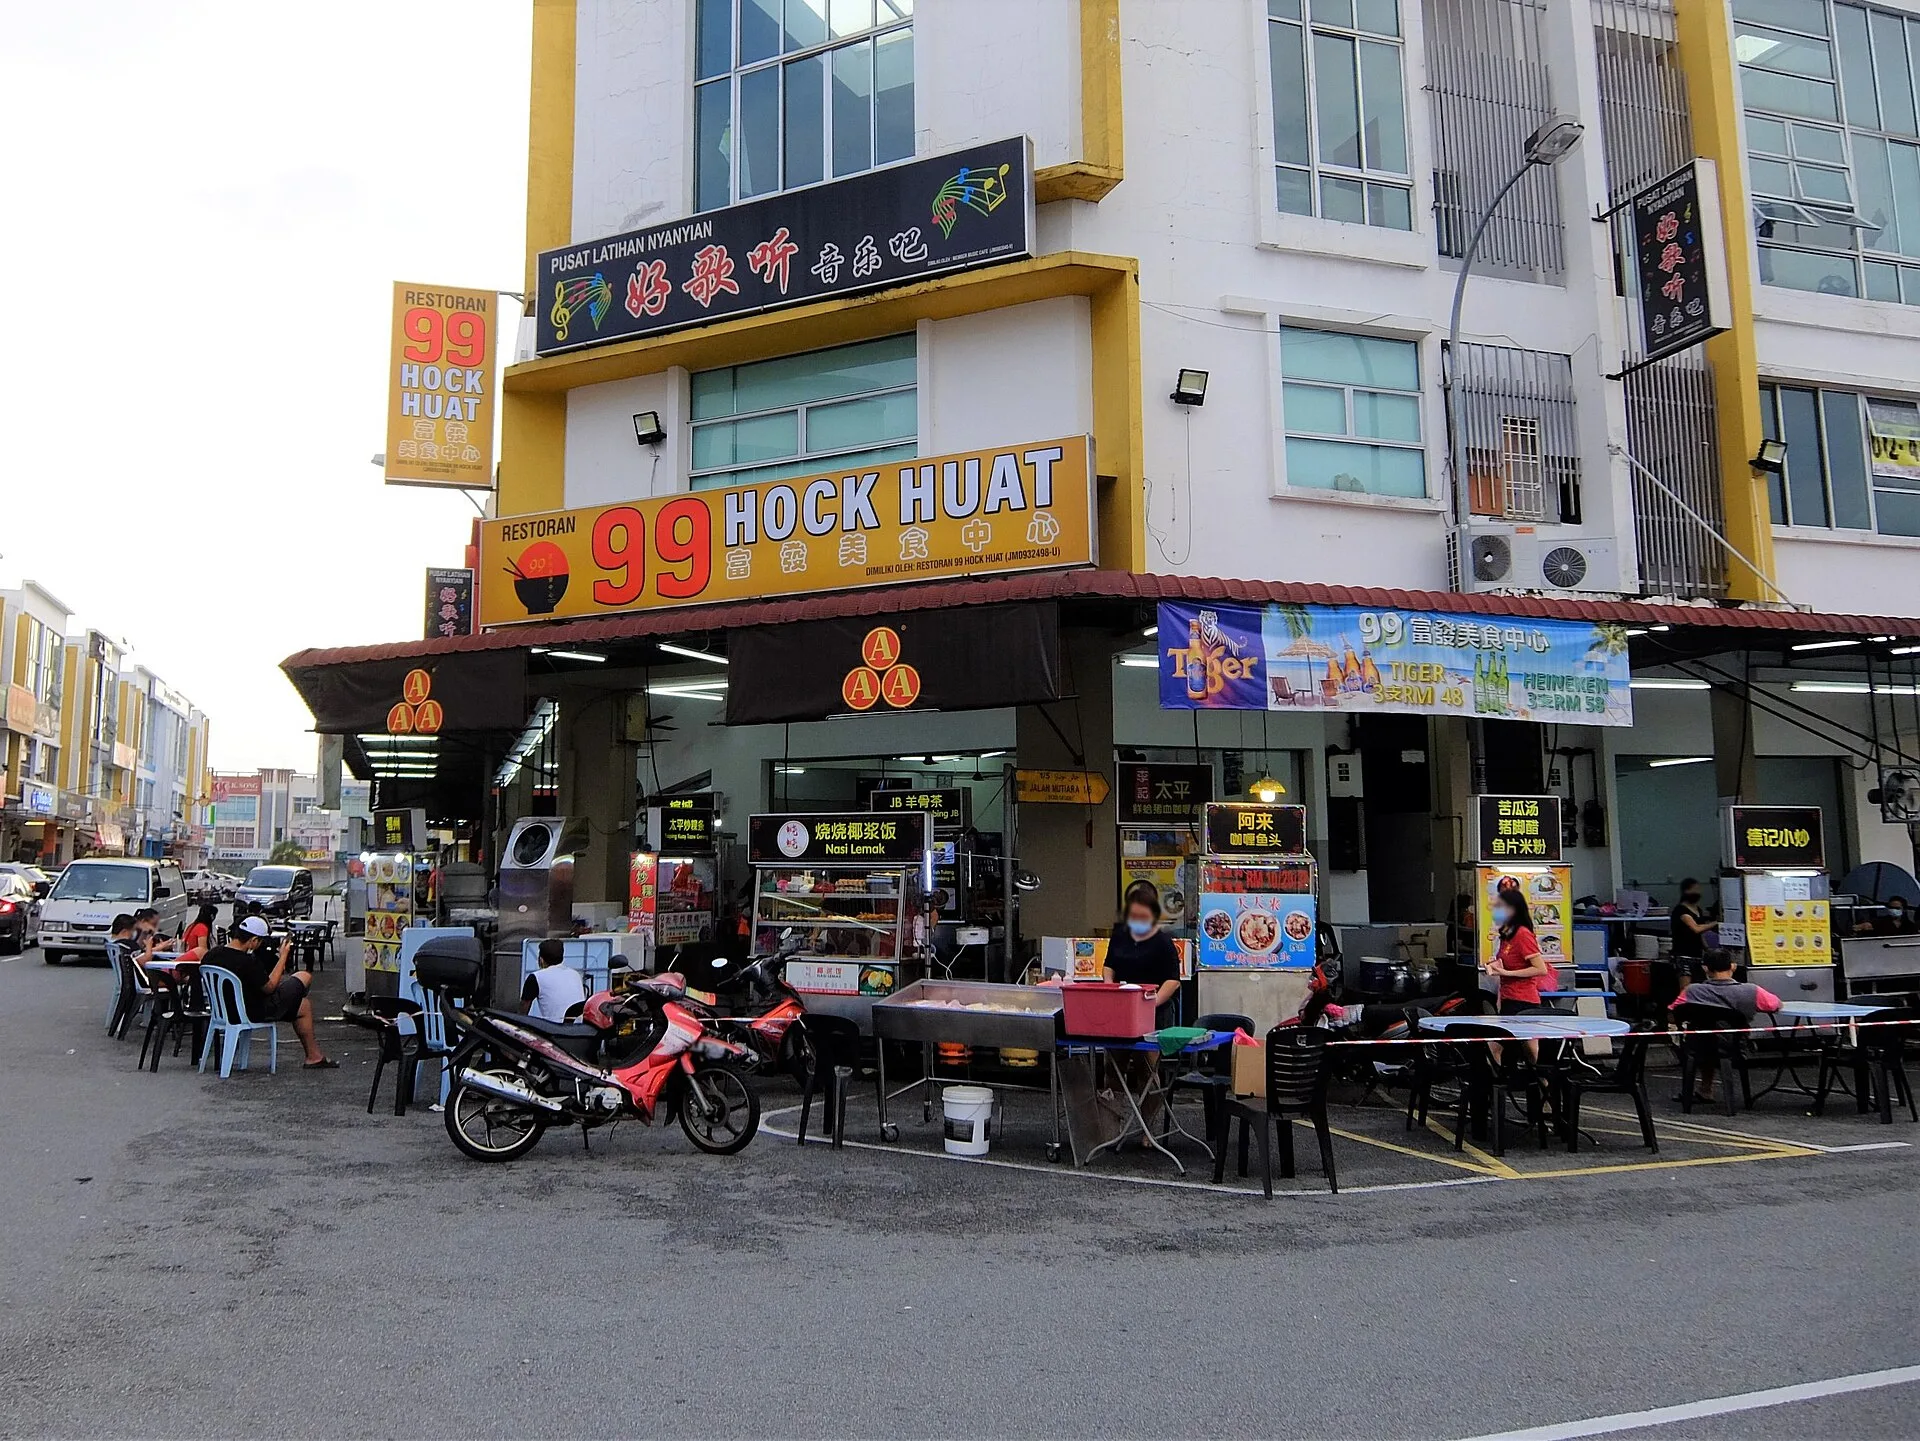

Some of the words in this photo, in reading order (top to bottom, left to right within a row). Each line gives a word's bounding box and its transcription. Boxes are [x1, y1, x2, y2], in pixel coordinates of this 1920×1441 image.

[551, 250, 590, 274] PUSAT
[592, 236, 645, 264] LATIHAN
[648, 220, 712, 250] NYANYIAN
[624, 226, 798, 318] 好歌听
[405, 290, 486, 312] RESTORAN
[404, 307, 486, 368] 99
[400, 362, 484, 394] HOCK
[402, 392, 481, 422] HUAT
[398, 440, 480, 462] 美食中心
[502, 516, 576, 542] RESTORAN
[592, 498, 712, 606] 99
[724, 472, 880, 546] HOCK
[898, 446, 1064, 526] HUAT
[530, 558, 546, 574] 99
[866, 565, 894, 576] DIMILIKI
[916, 558, 953, 571] RESTORAN
[954, 557, 964, 566] 99
[964, 555, 984, 566] HOCK
[986, 552, 1004, 564] HUAT
[1358, 612, 1404, 646] 99
[1410, 618, 1550, 652] 富發美食中心
[1167, 646, 1258, 694] Tger
[1389, 661, 1447, 684] TIGER
[1523, 672, 1609, 696] HEINEKEN
[1440, 686, 1464, 708] 48
[1586, 696, 1606, 714] 58
[890, 796, 902, 808] JB
[906, 794, 943, 808] 羊骨茶
[1155, 780, 1190, 800] 太平
[1498, 800, 1538, 817] 苦瓜汤
[815, 822, 897, 840] 烧烧椰浆饭
[1238, 812, 1274, 830] 阿来
[1498, 819, 1539, 836] 猪脚醋
[826, 843, 848, 854] Nasi
[850, 842, 886, 854] Lemak
[1230, 832, 1282, 846] 咖喱鱼头
[1492, 838, 1546, 855] 鱼片米粉
